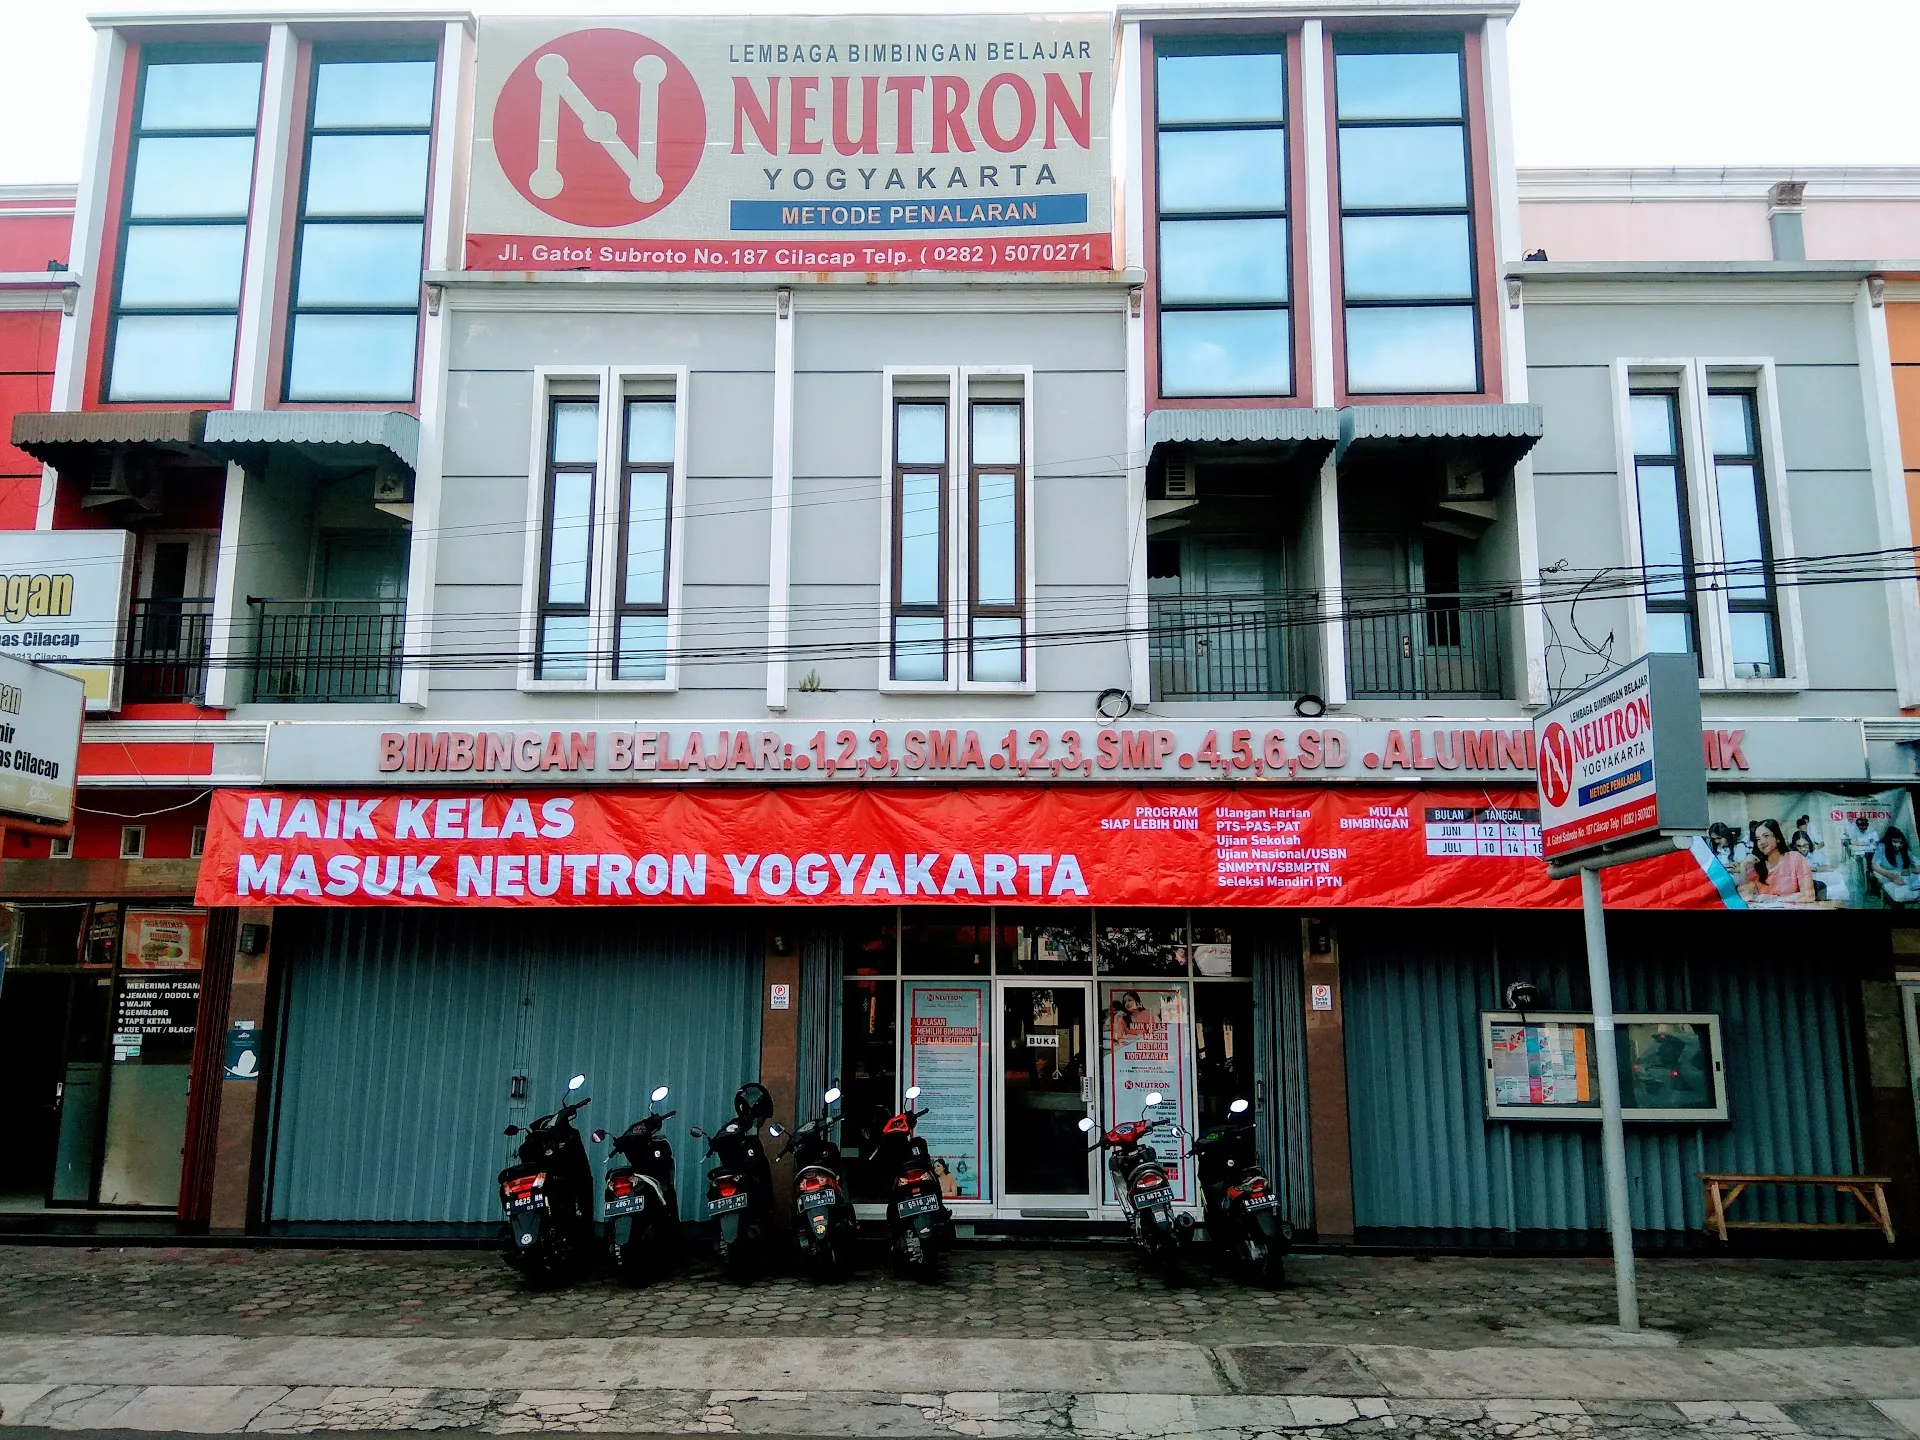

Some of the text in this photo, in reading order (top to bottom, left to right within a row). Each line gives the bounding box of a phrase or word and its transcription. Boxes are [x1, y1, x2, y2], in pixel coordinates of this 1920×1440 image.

[729, 40, 1092, 63] LEMBAGA BIMBINGAN BELAJAR
[730, 71, 1093, 156] NEUTRON
[763, 163, 1057, 191] YOGYAKARTA
[782, 201, 1038, 225] METODE PENALARAN
[498, 244, 523, 262] Jl.
[531, 244, 592, 262] Gatot
[599, 246, 687, 265] Subroto
[694, 248, 767, 265] No.187
[775, 249, 855, 267] Cilacap
[862, 248, 912, 266] Telp.
[933, 245, 984, 262] 0282
[1004, 242, 1092, 262] 5070271
[23, 632, 79, 647] Cilacap
[1570, 674, 1649, 724] LEMBAGA BIMBINGAN BELAJAR
[1572, 693, 1651, 763] NEUTRON
[378, 731, 596, 772] BIMBINGAN
[1582, 740, 1646, 778] YOGYAKARTA
[13, 749, 59, 780] Cilacap
[1589, 772, 1641, 799] METODE PENALARAN
[243, 797, 575, 839] NAIK KELAS
[1136, 806, 1199, 818] PROGRAM
[1216, 807, 1311, 820] Ulangan Harian
[1368, 806, 1408, 818] MULAI
[1434, 809, 1524, 821] BULAN TANGGAL
[1100, 819, 1199, 830] SIAP LEBIH DINI
[1216, 820, 1300, 832] PTS-PAS-PAT
[1340, 818, 1409, 829] BIMBINGAN
[1441, 826, 1462, 837] JUNI
[1483, 826, 1494, 837] 12
[1216, 834, 1301, 848] Ujian Sekolah
[1442, 842, 1462, 853] JULI
[1484, 842, 1495, 853] 10
[1507, 843, 1519, 853] 14
[1217, 848, 1347, 861] Ujian Nasional/USBN
[236, 853, 1090, 897] MASUK NEUTRON YOGYAKARTA
[1217, 862, 1330, 874] SNMPTN/SBMPTN
[1218, 875, 1342, 887] Seleksi Mandiri PTN
